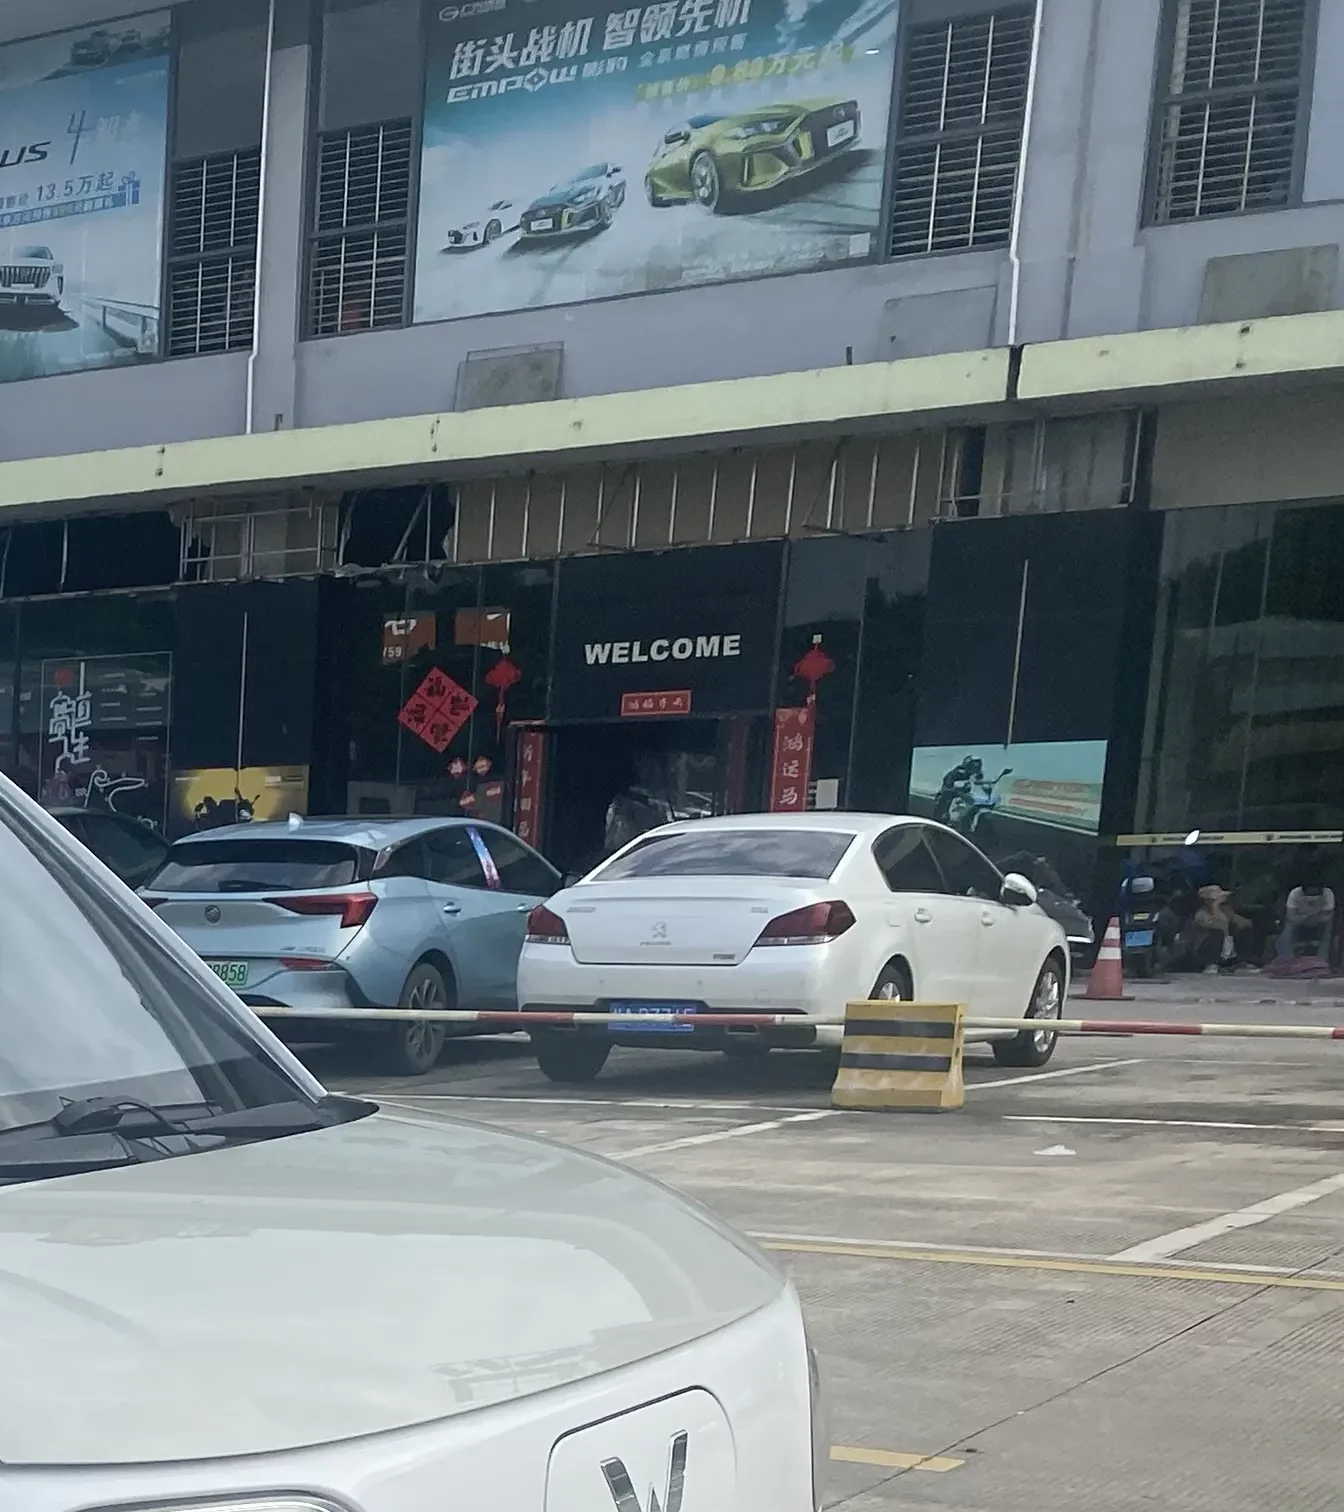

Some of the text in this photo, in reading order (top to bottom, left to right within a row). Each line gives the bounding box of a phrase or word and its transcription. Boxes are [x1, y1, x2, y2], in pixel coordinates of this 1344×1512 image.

[449, 17, 594, 80] 街头战机
[603, 0, 752, 51] 智领先机
[585, 634, 742, 665] WELCOME
